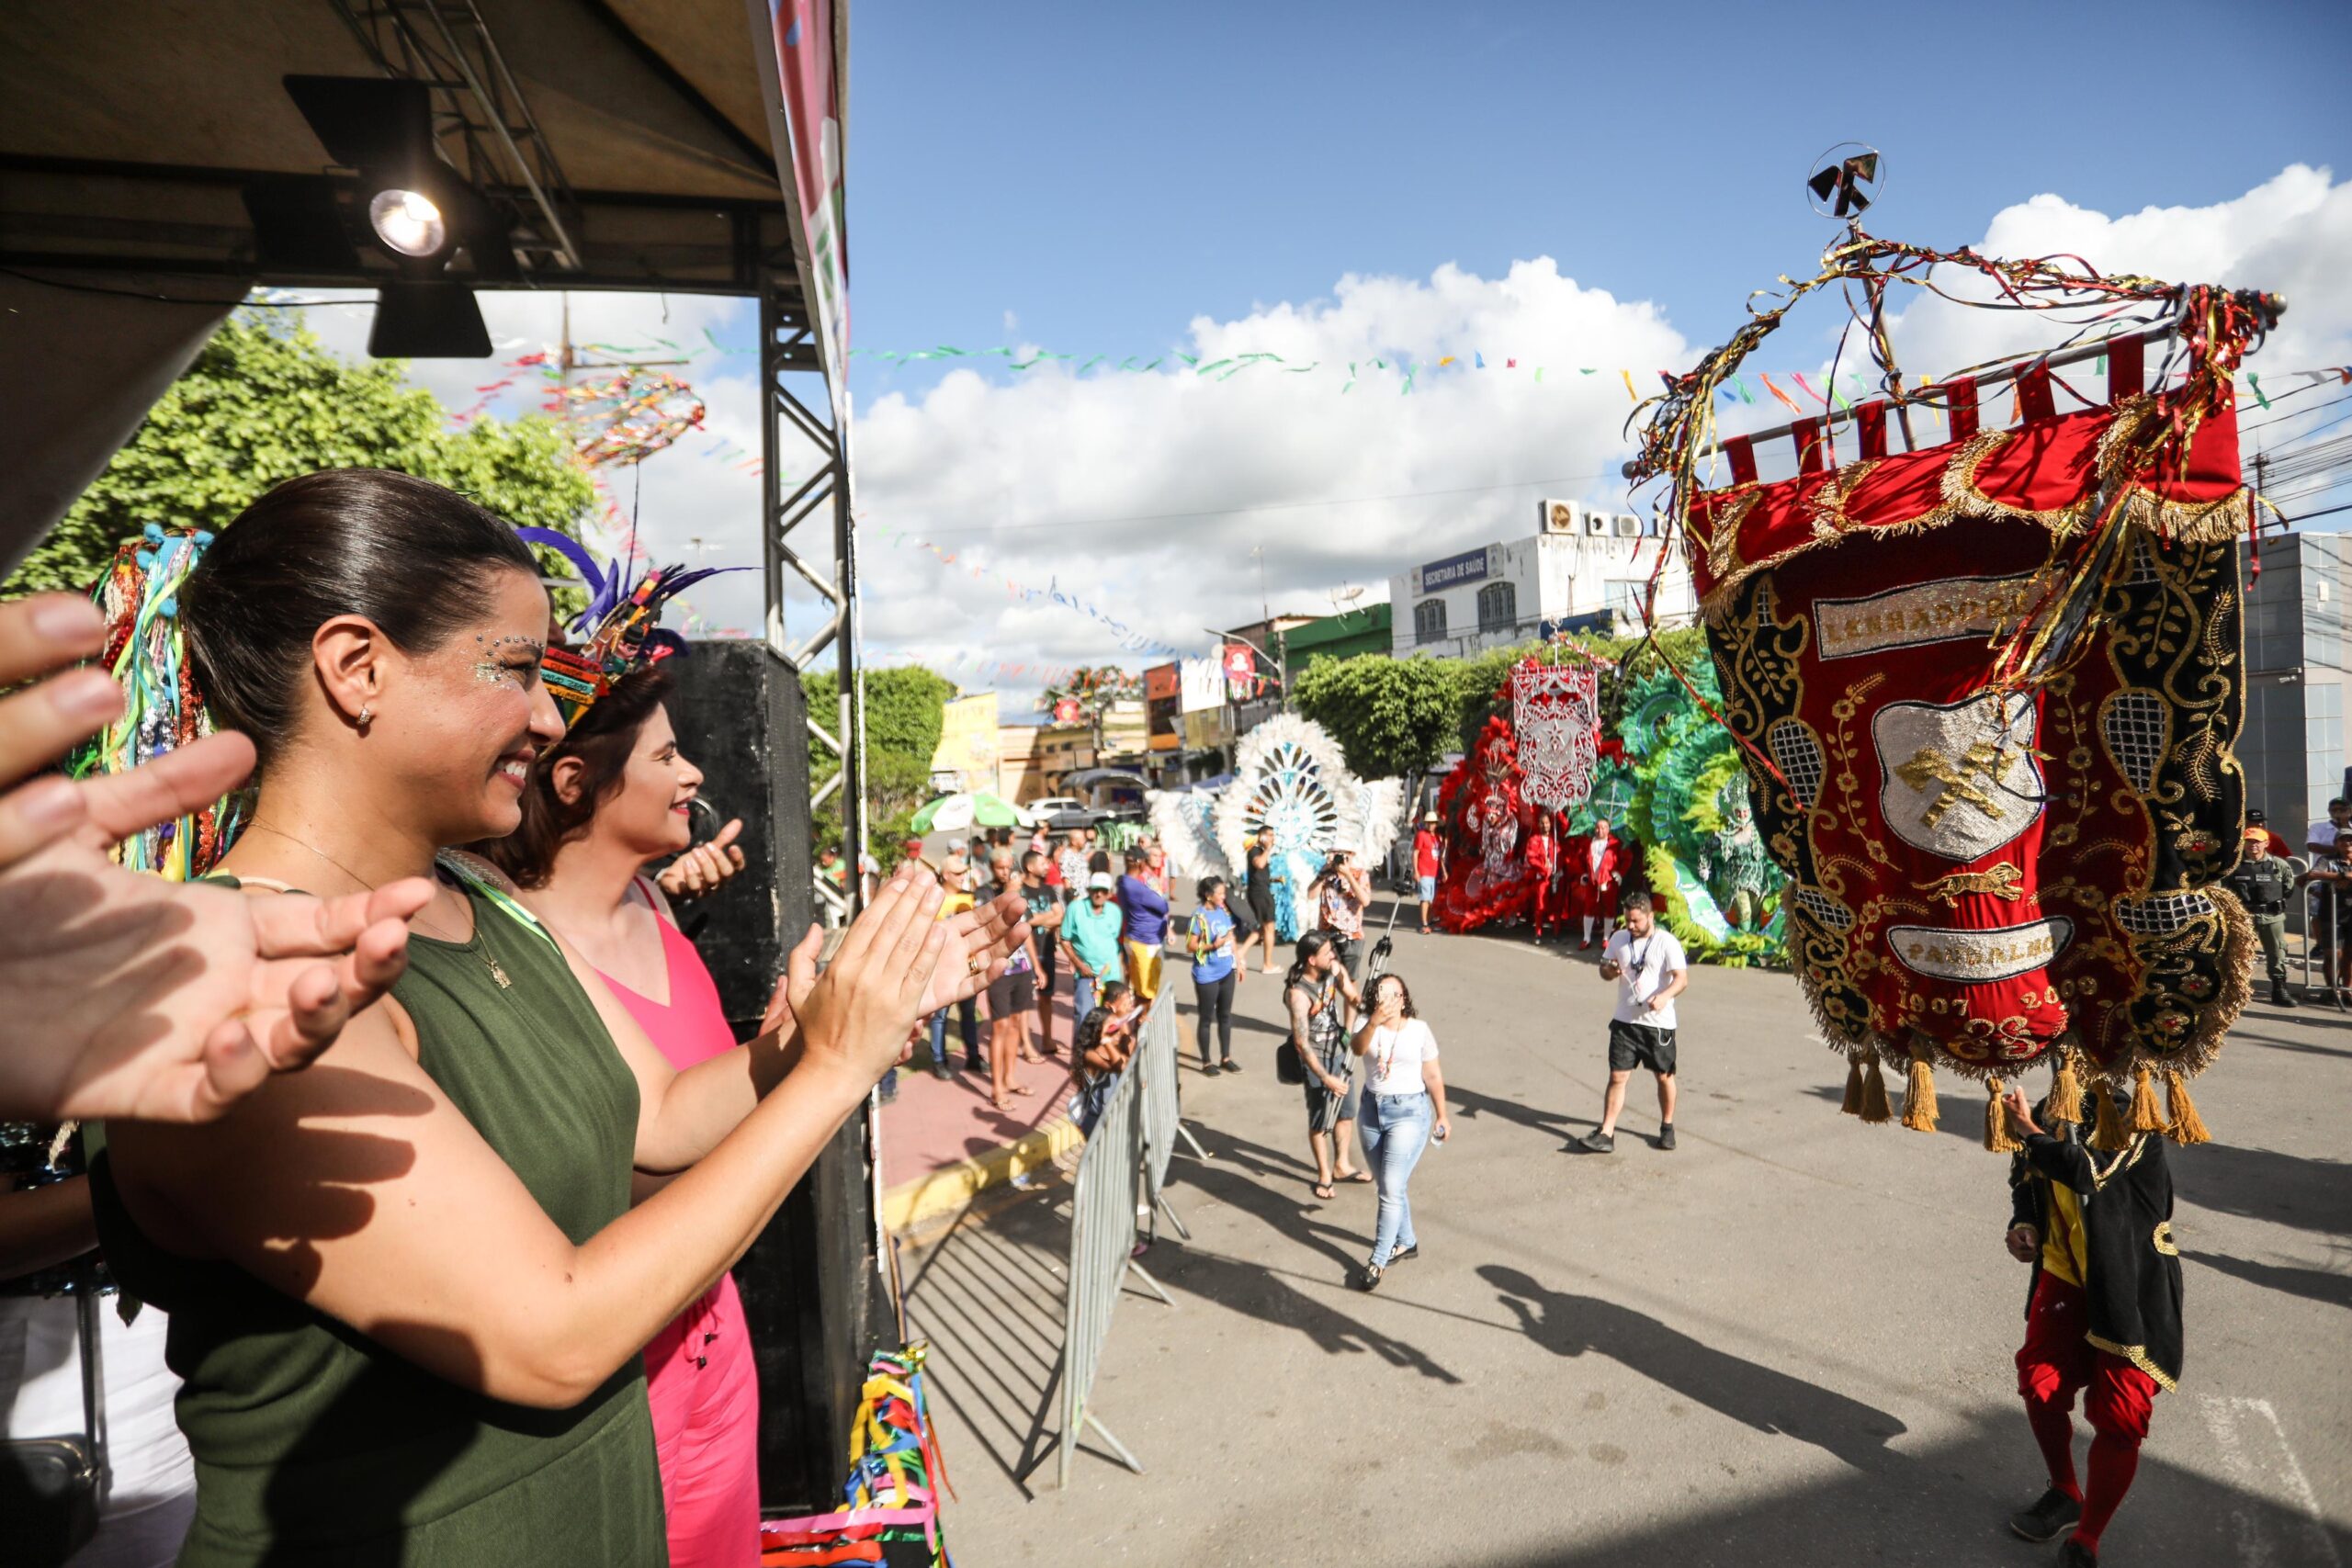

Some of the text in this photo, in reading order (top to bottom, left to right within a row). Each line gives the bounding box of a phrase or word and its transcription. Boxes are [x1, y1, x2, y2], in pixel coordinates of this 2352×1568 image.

[1425, 566, 1456, 586] SECRETARIA
[1457, 562, 1465, 578] DE
[550, 662, 583, 677] OLINDA
[567, 681, 589, 692] ZERO
[1907, 935, 2054, 965] PAUDALHO
[1896, 988, 1969, 1017] 1907
